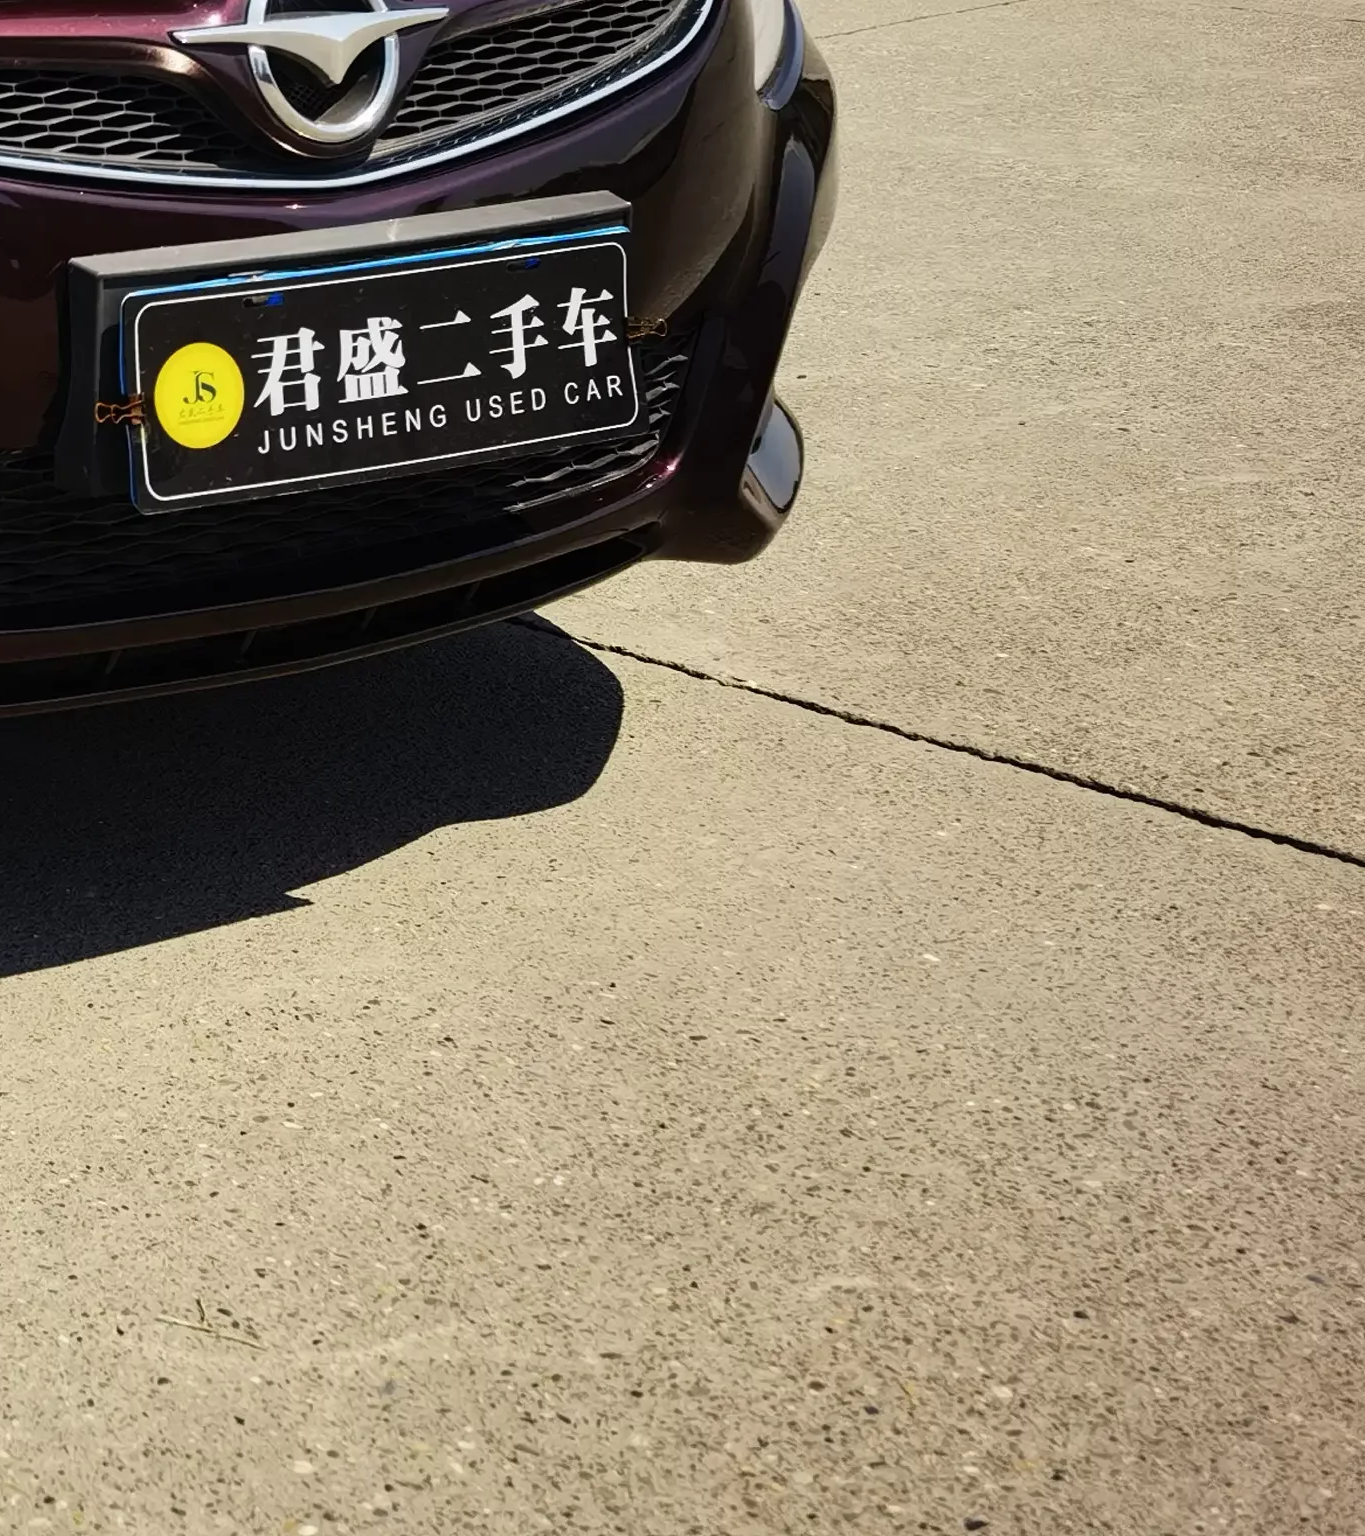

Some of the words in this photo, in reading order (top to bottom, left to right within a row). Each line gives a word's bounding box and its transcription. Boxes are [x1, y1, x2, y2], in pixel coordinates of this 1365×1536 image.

[250, 287, 618, 416] 君盛二手车
[257, 402, 448, 455] JUNSHENG
[465, 387, 547, 422] USED
[564, 374, 623, 406] CAR
